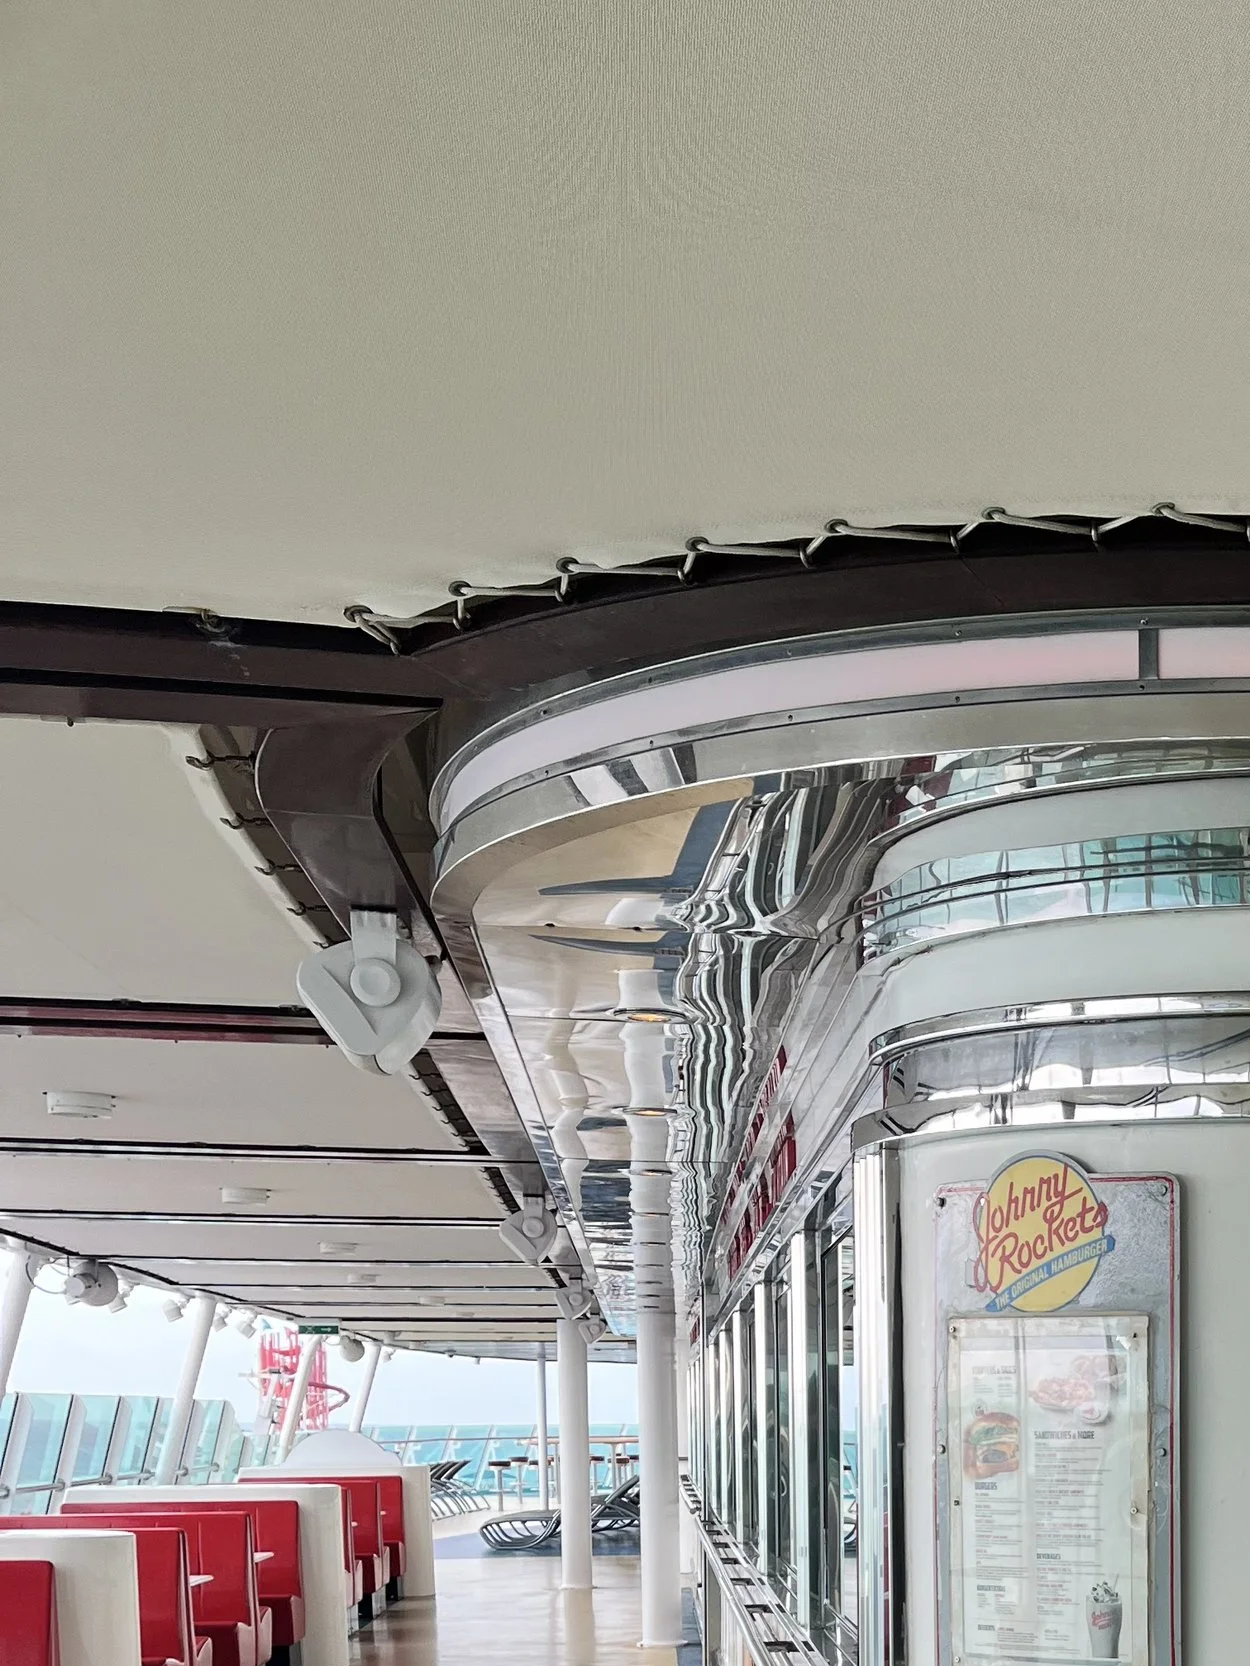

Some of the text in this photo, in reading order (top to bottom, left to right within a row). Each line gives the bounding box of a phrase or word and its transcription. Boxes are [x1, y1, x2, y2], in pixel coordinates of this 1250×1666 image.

[973, 1162, 1083, 1293] Johnny
[988, 1196, 1109, 1293] Rockets
[1011, 1267, 1049, 1298] ORIGINAL
[1051, 1239, 1108, 1274] HAMBURGER
